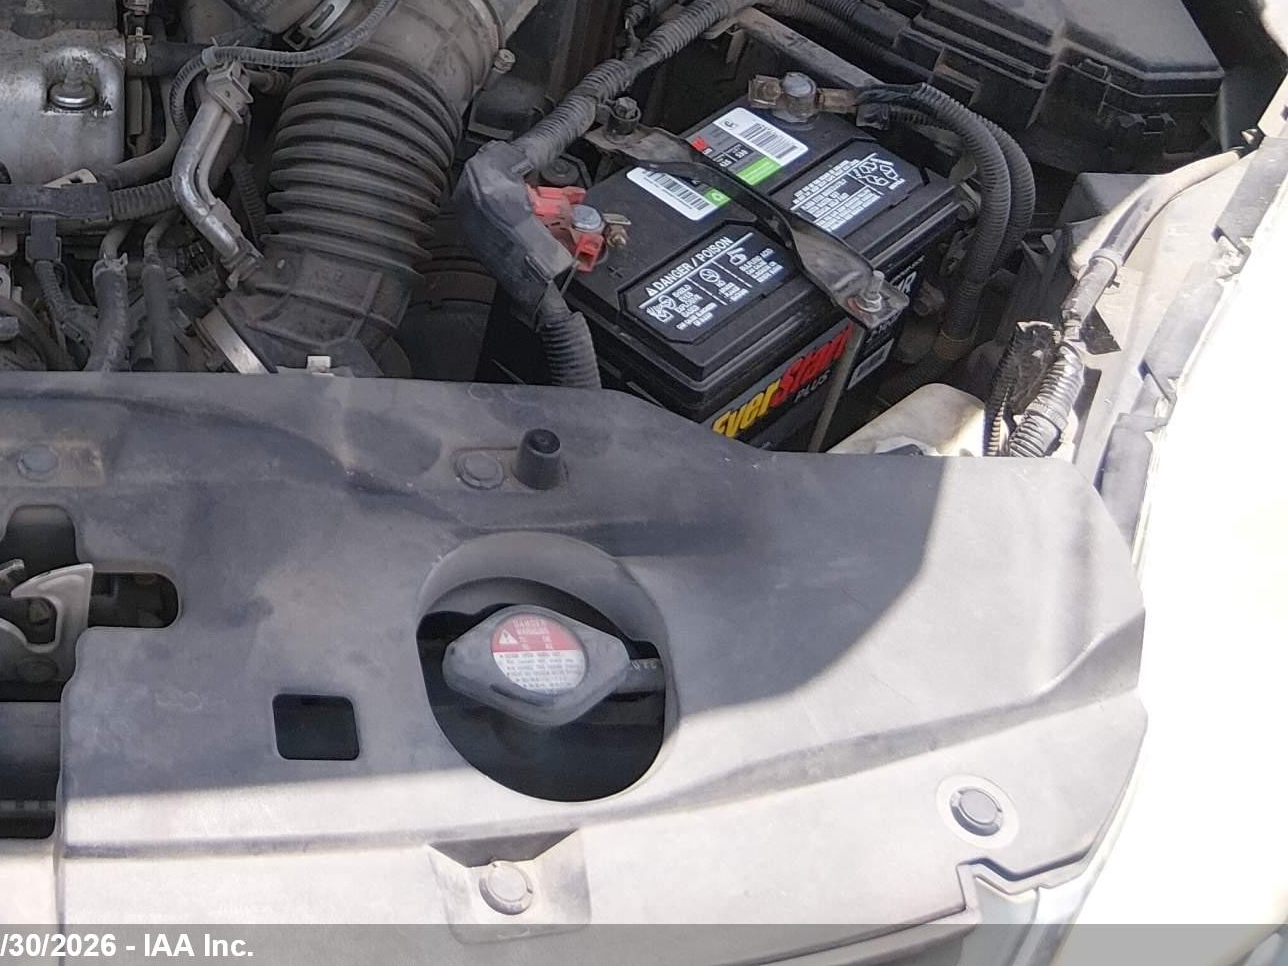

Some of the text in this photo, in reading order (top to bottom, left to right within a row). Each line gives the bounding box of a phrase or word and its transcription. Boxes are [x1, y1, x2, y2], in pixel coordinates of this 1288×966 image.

[652, 262, 694, 292] DANGER
[695, 236, 734, 263] POISON
[794, 369, 832, 403] PLUS
